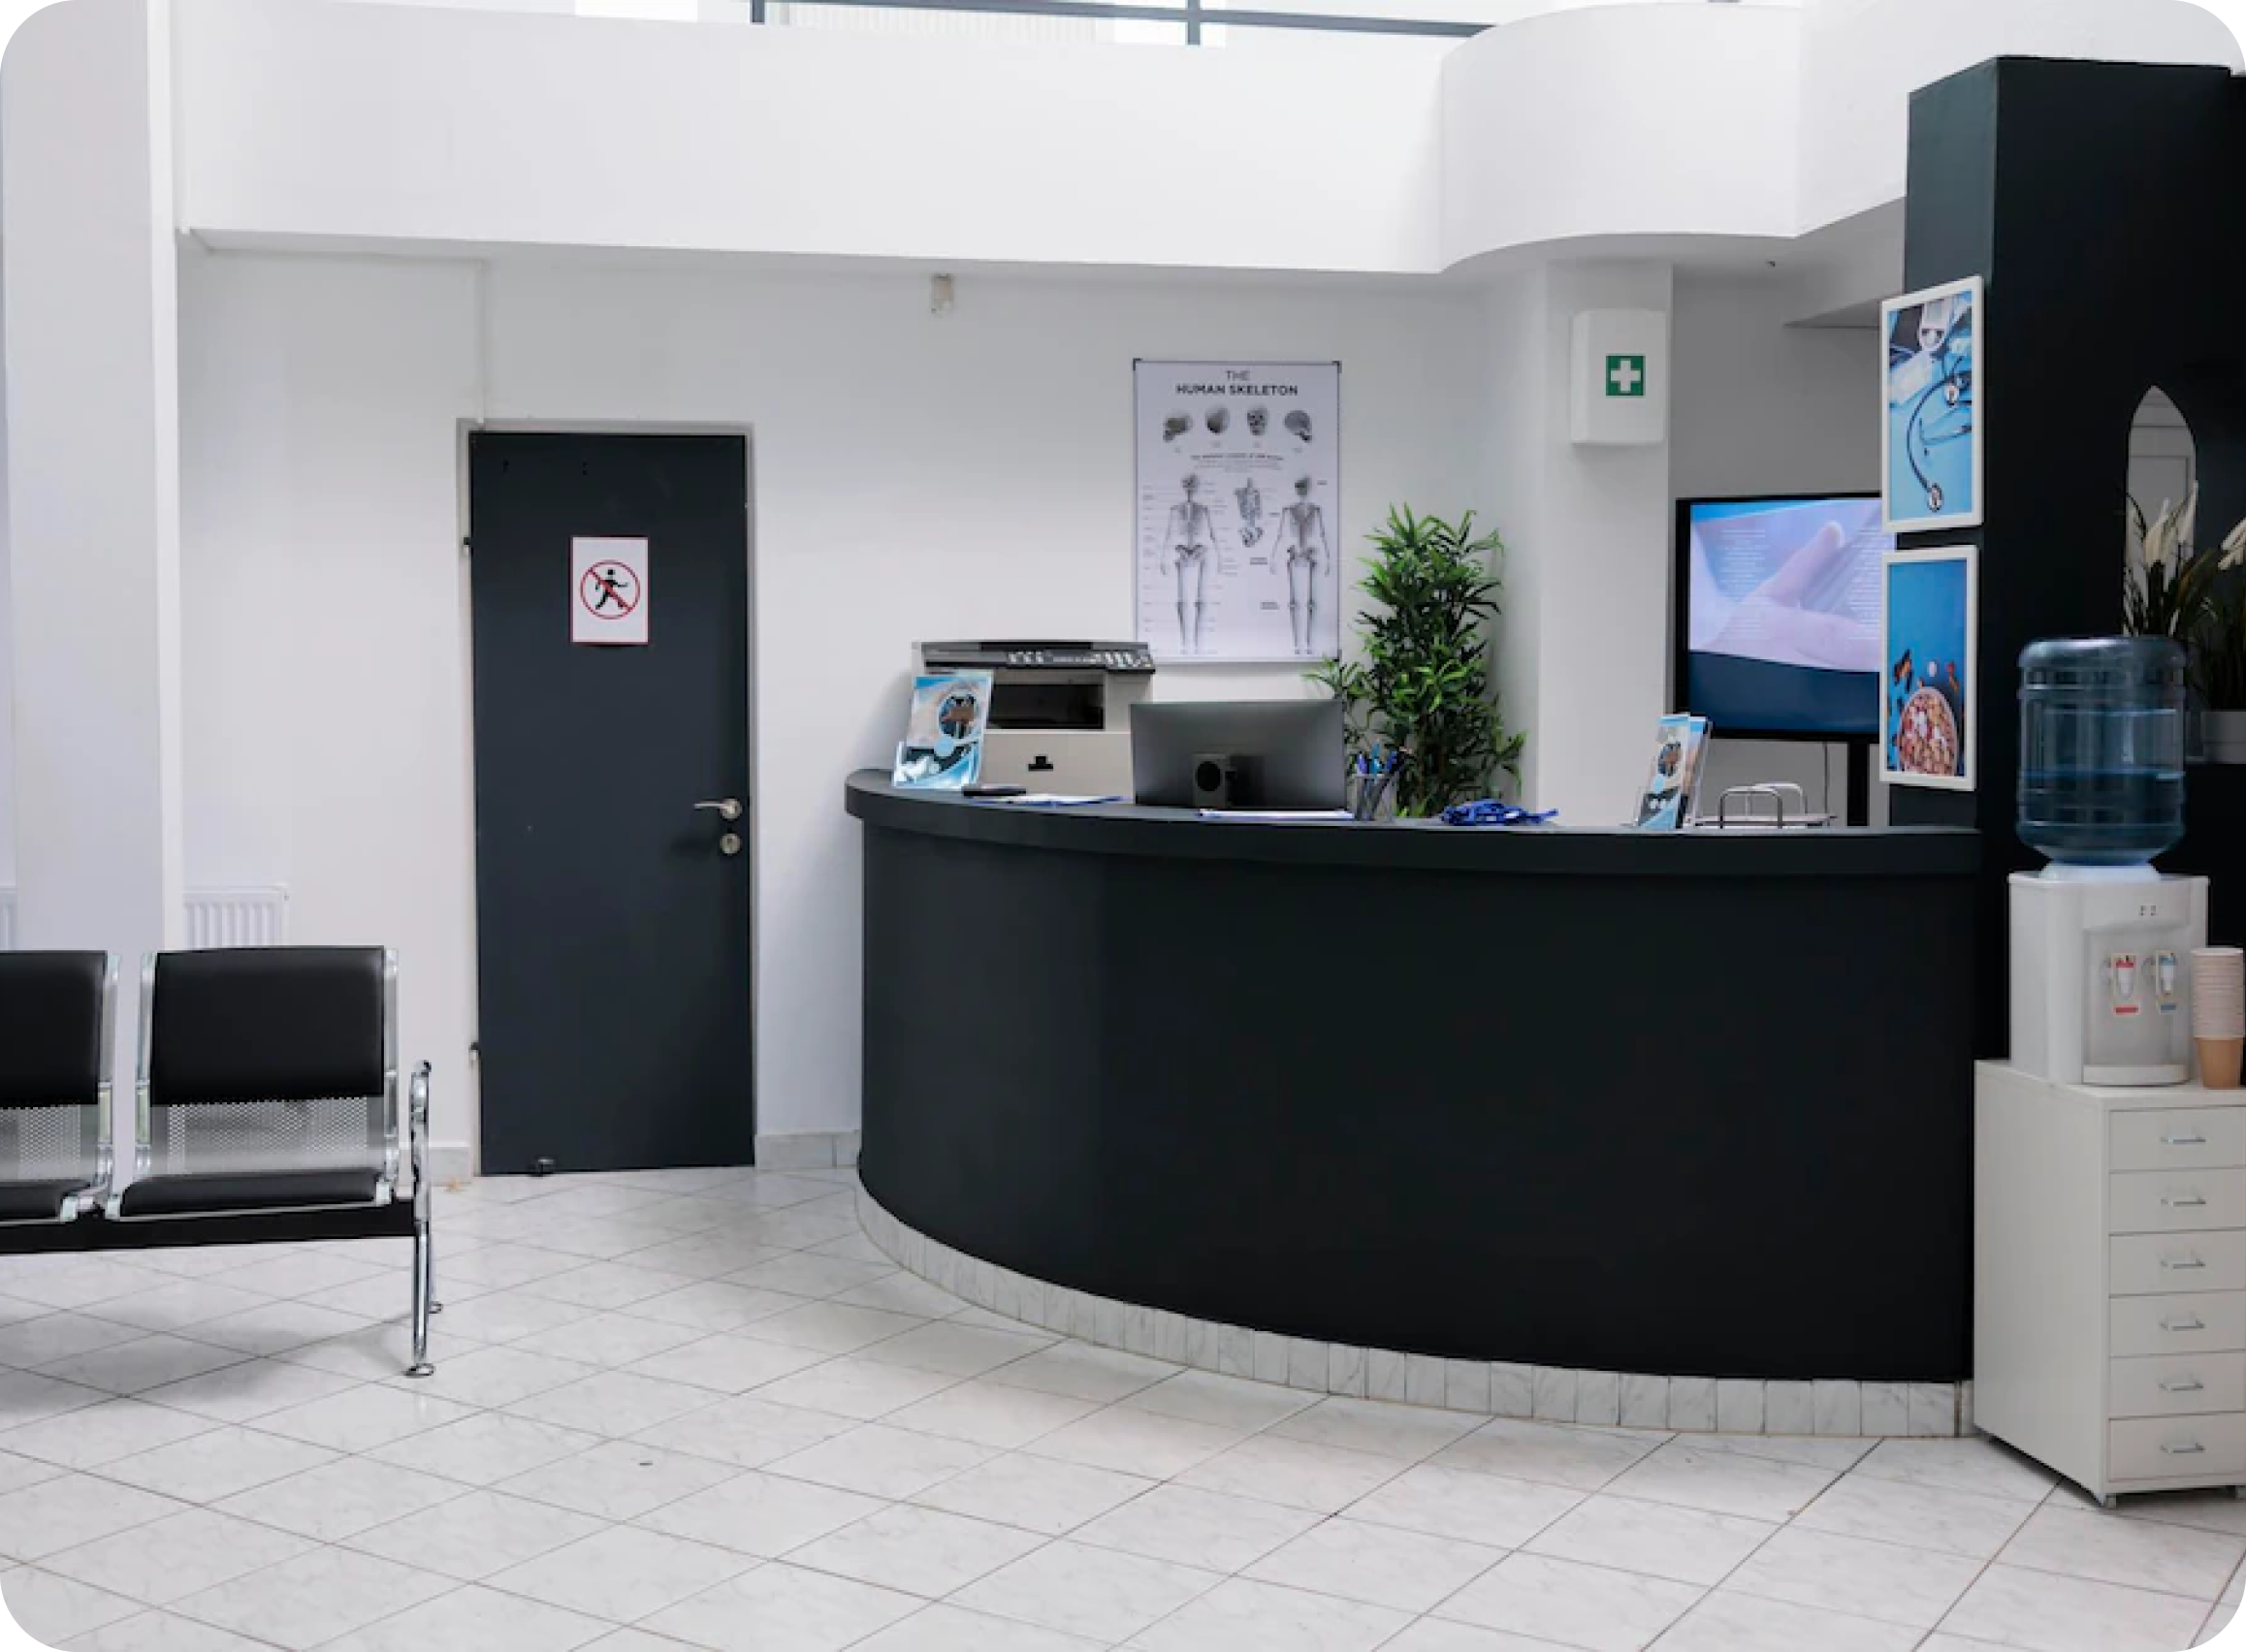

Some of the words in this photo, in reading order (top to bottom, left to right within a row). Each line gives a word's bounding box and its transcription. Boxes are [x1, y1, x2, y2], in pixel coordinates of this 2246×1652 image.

[1225, 369, 1250, 381] THE
[1175, 384, 1226, 395] HUMAN
[1229, 384, 1299, 396] SKELETON
